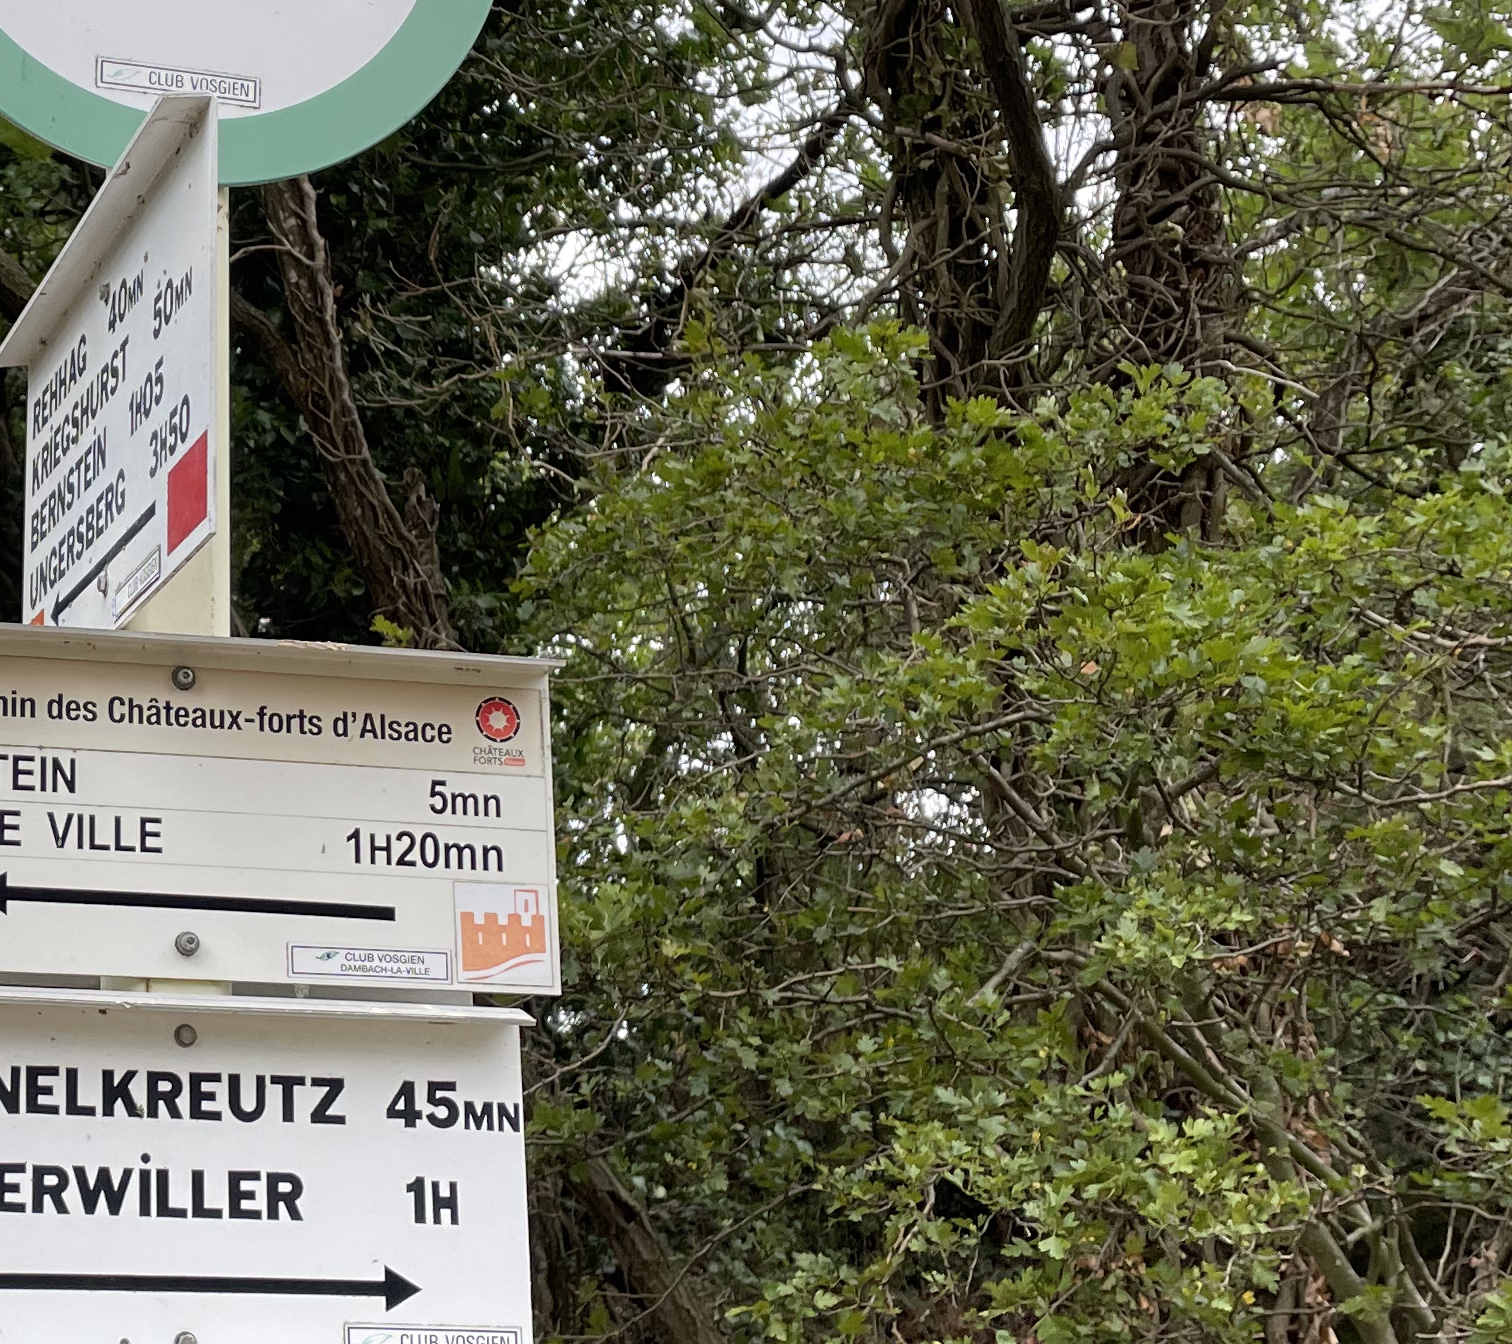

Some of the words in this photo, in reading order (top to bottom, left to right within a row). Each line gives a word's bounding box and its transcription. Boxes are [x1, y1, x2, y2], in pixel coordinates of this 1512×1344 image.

[149, 71, 184, 88] CLUB
[190, 75, 250, 98] VOSGIEN
[33, 333, 87, 440] REHHAG
[129, 355, 163, 438] 1H05
[30, 468, 125, 610] UNGERSBERG
[149, 394, 190, 479] 3H50
[48, 693, 98, 723] des
[108, 696, 323, 737] Châteaux-forts
[333, 711, 453, 744] d'Alsace
[474, 756, 503, 766] FORTS
[429, 779, 502, 818] 5mn
[47, 811, 163, 854] VILLE
[346, 827, 504, 872] 1H20mn
[340, 964, 430, 976] DAMBACH-LA-VILLE
[344, 952, 374, 962] CLUB
[376, 954, 425, 965] VOSGIEN
[387, 1080, 520, 1133] 45MN
[405, 1176, 460, 1226] 1H
